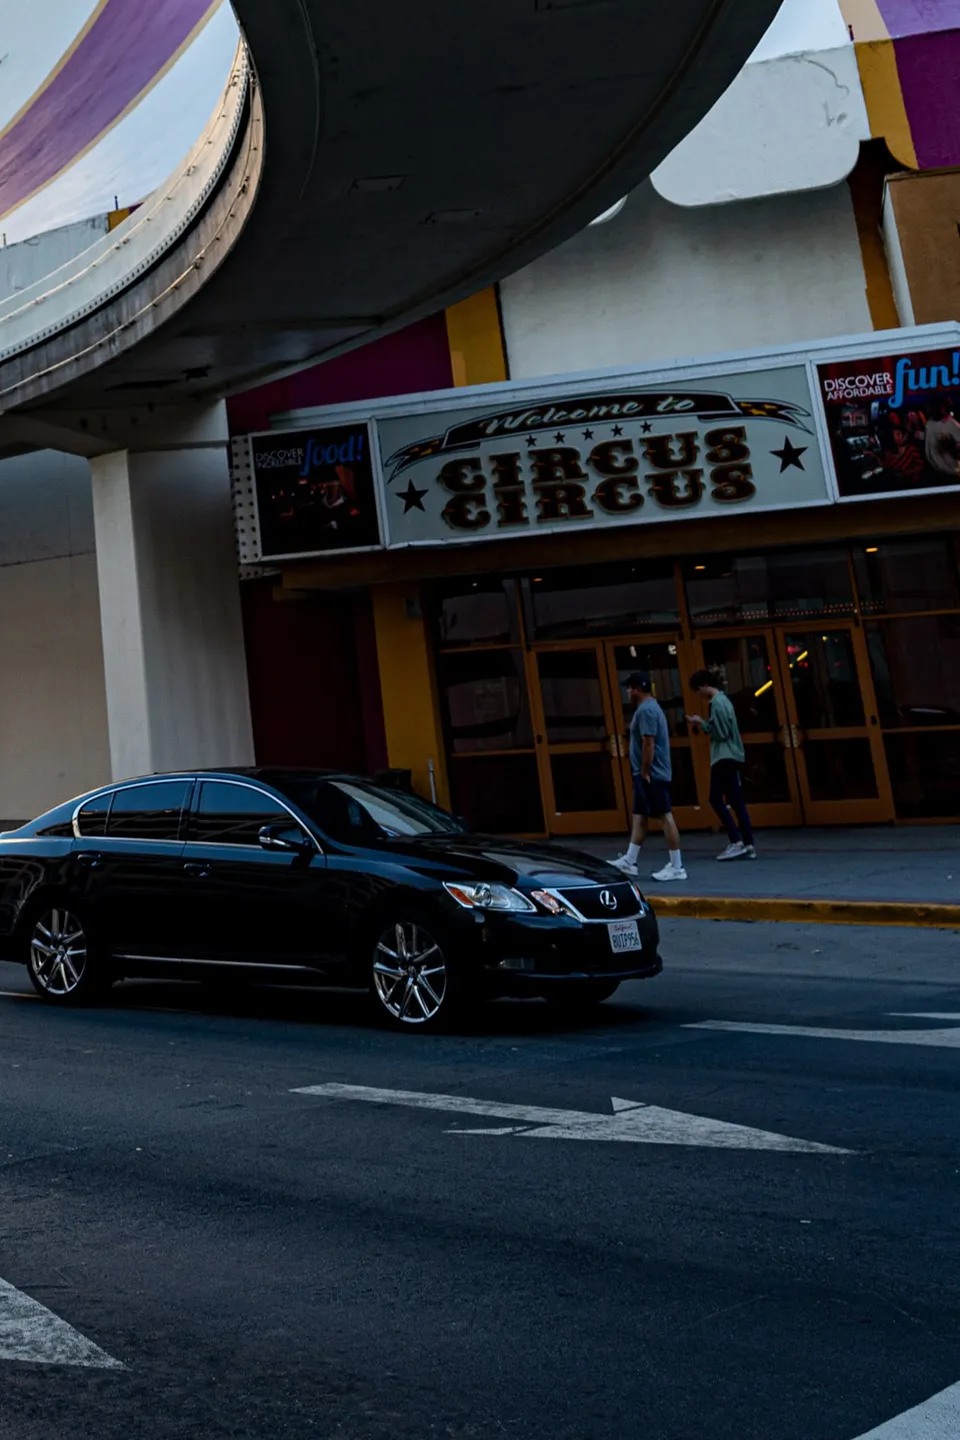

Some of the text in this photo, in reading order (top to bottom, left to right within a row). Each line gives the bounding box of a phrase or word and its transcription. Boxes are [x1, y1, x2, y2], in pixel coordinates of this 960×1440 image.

[824, 372, 893, 392] DISCOVER
[826, 384, 893, 401] AFFORDABLE
[888, 351, 960, 409] fun!
[479, 395, 696, 435] Welcome to
[255, 447, 304, 462] DISCOVER
[299, 434, 364, 477] food!
[437, 426, 750, 494] CIRCUS
[441, 463, 756, 530] CIRCUS
